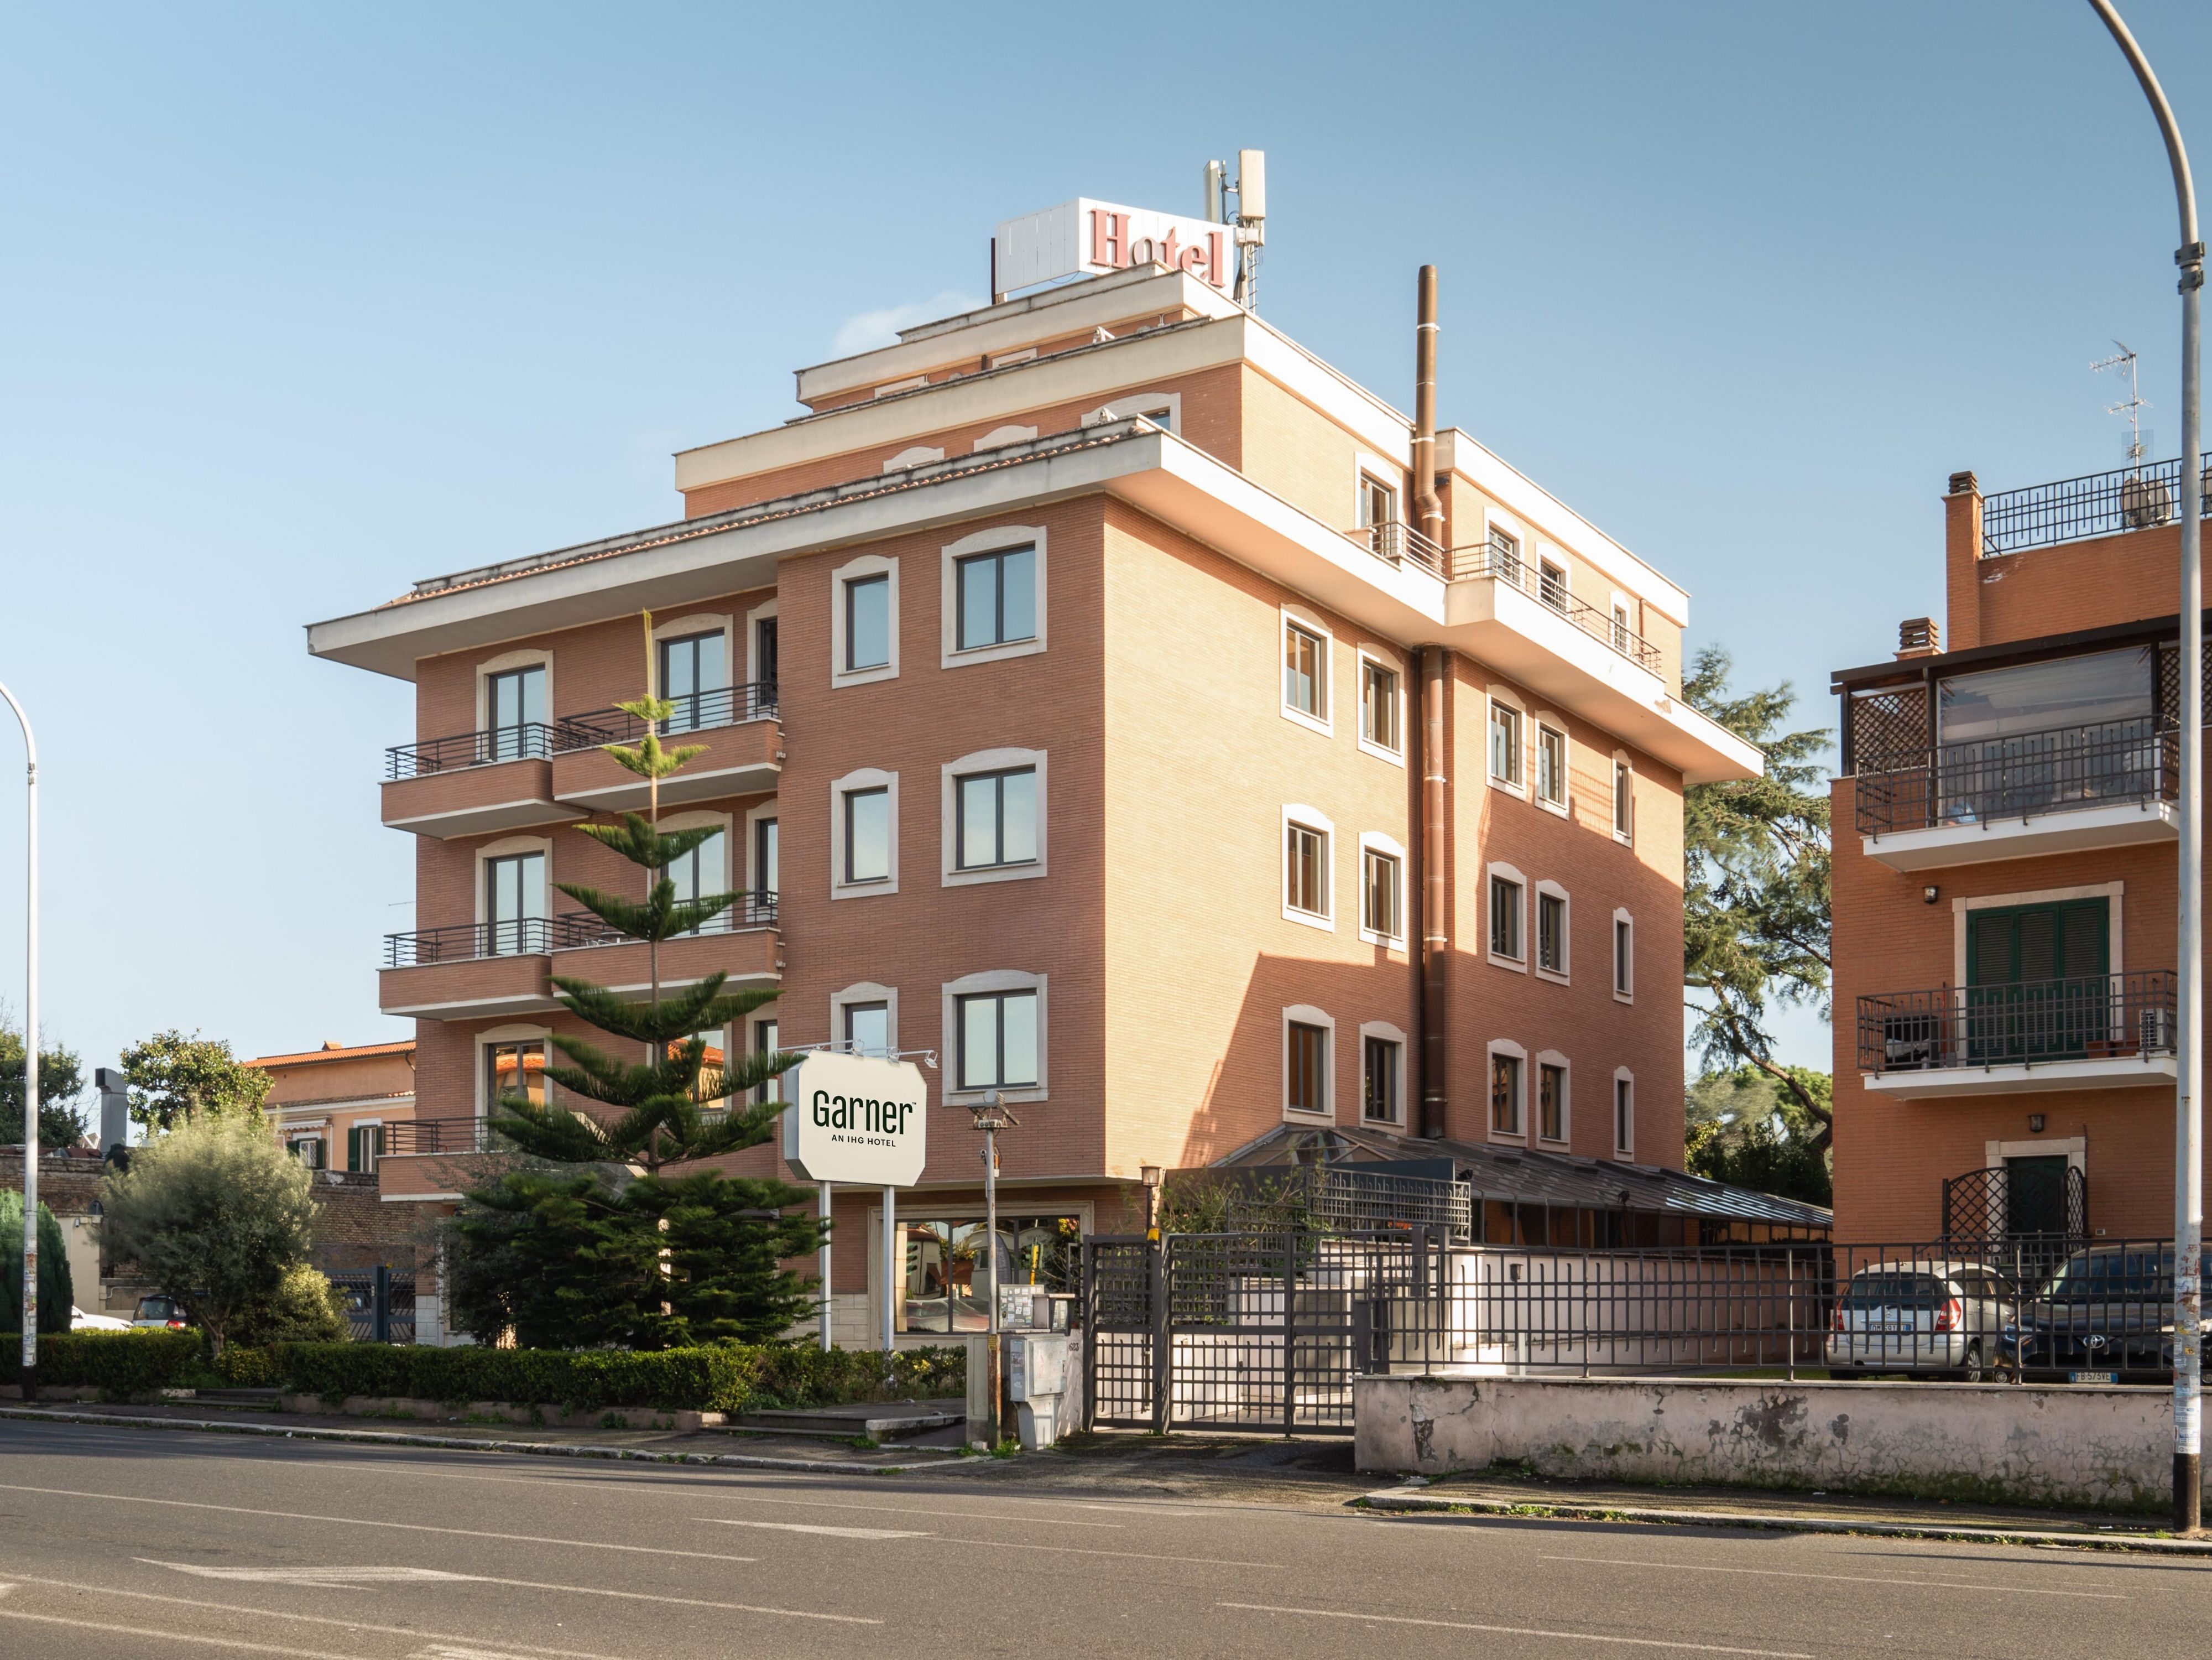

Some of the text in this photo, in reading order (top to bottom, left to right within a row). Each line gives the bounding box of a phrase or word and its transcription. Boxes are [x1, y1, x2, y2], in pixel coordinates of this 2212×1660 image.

[1090, 208, 1226, 288] Hotel
[813, 1090, 912, 1135] Garner
[868, 1138, 896, 1147] HOTEL
[1069, 1342, 1079, 1351] 623
